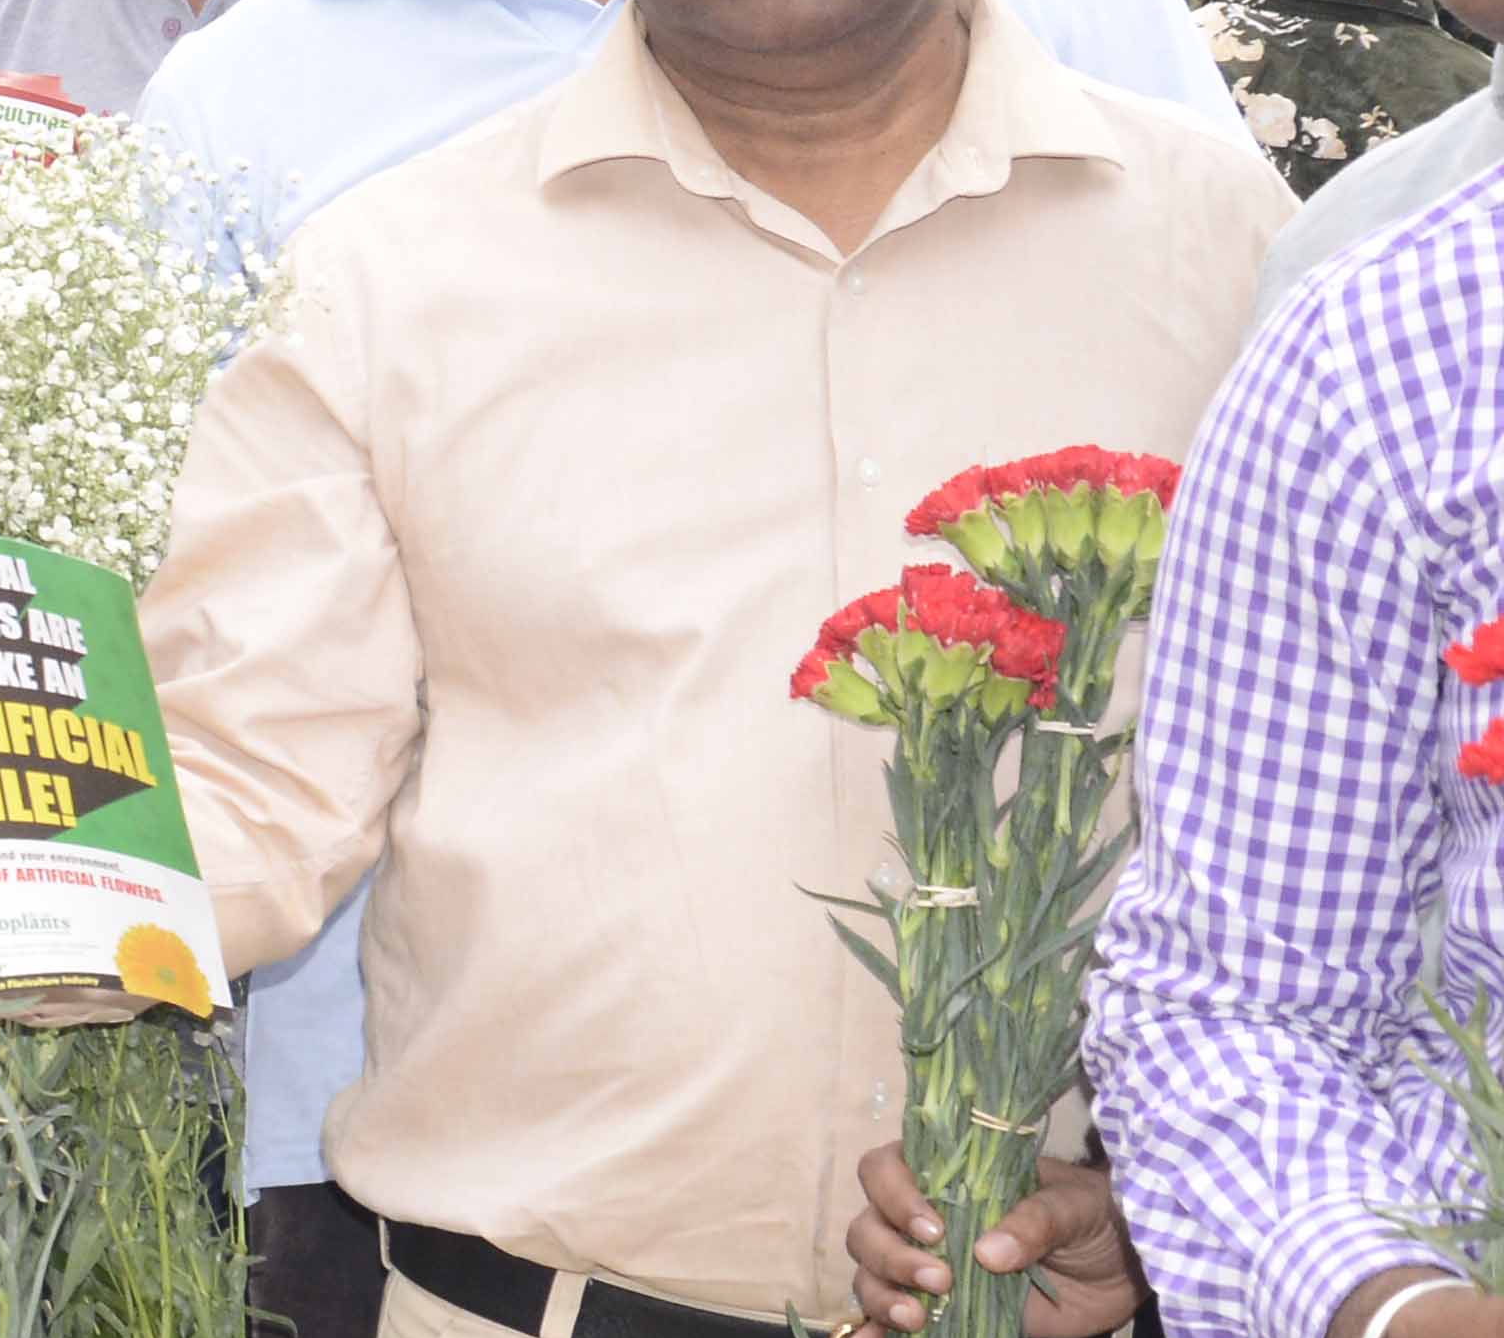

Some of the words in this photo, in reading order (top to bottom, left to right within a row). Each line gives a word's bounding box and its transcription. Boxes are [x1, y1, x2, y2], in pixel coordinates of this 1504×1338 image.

[27, 607, 88, 655] ARE
[43, 658, 88, 701] AN
[15, 868, 97, 888] ARTIFICIAL
